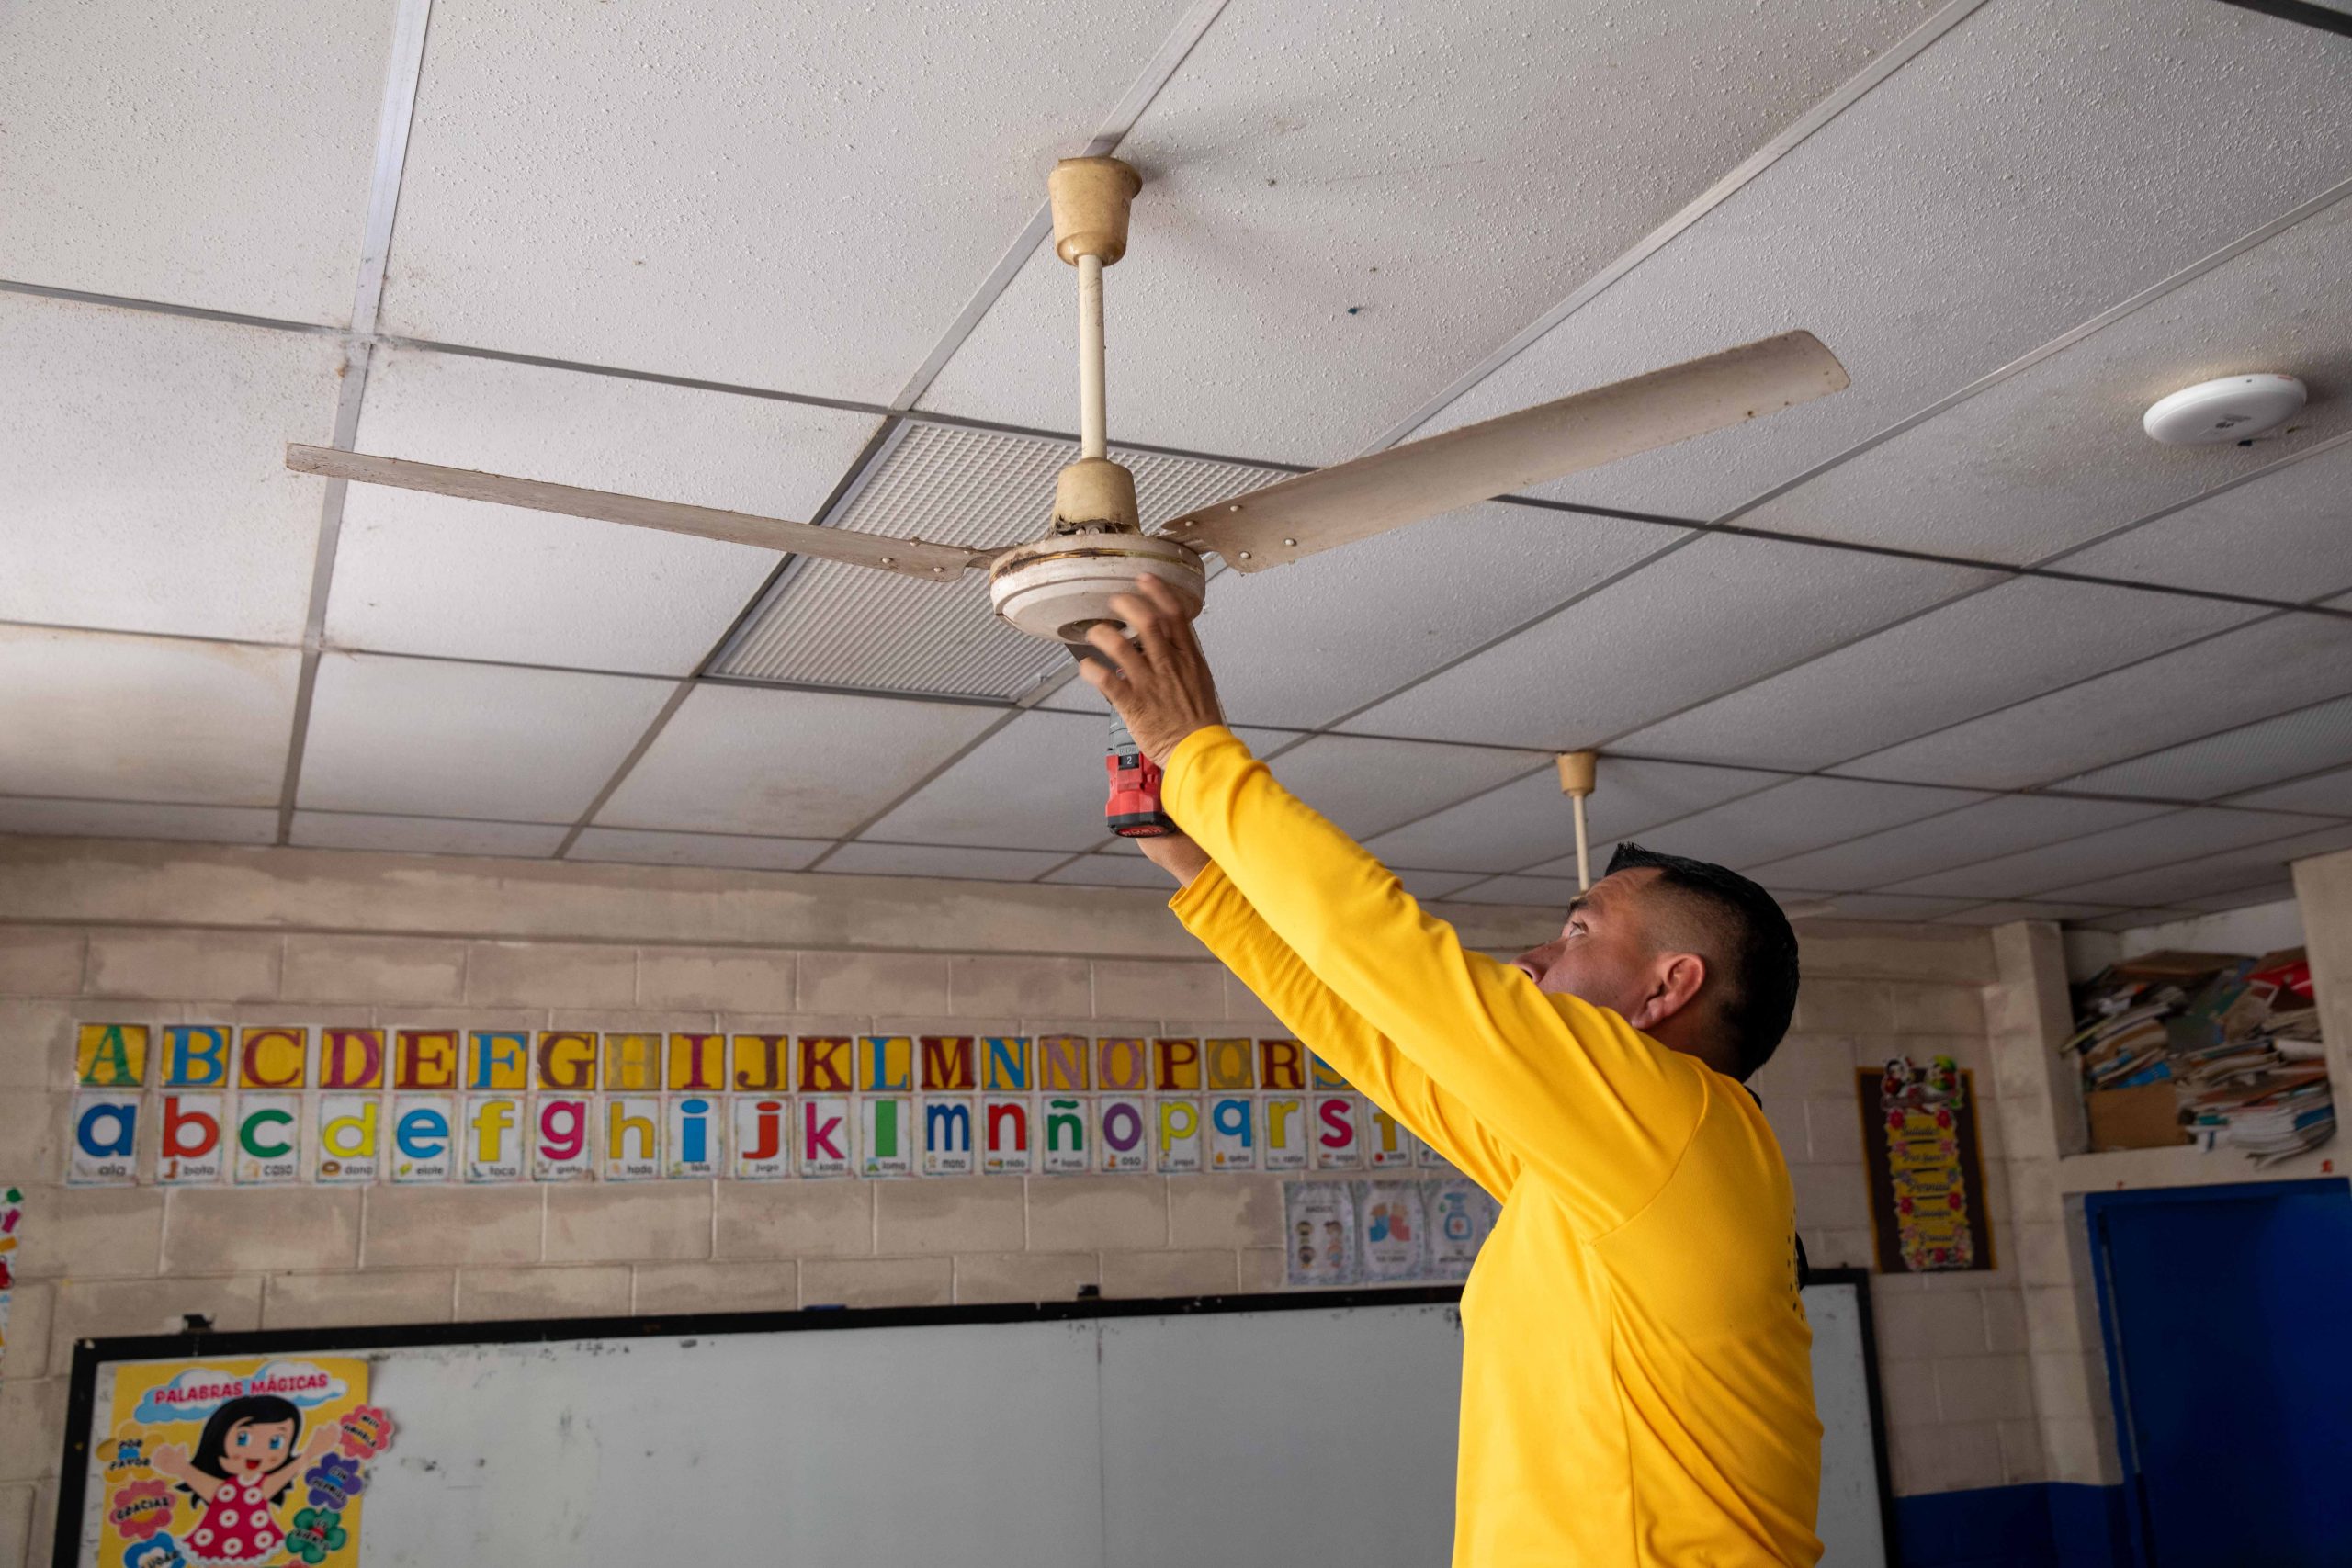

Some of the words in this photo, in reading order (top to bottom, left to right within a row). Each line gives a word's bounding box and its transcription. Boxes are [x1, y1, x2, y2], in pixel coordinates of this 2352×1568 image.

[1126, 755, 1133, 765] 2
[79, 1024, 137, 1086] A
[165, 1026, 223, 1086] B
[243, 1030, 301, 1087] C
[324, 1032, 379, 1088] D
[398, 1032, 454, 1088] E
[471, 1033, 525, 1088] F
[540, 1034, 596, 1088] G
[604, 1035, 660, 1089] H
[683, 1034, 712, 1089] I
[737, 1036, 784, 1089] J
[798, 1038, 851, 1090] K
[868, 1037, 907, 1089] L
[920, 1038, 975, 1088] M
[986, 1038, 1027, 1088] N
[1102, 1039, 1142, 1089] O
[1158, 1040, 1197, 1089] P
[1261, 1040, 1304, 1089] R
[78, 1103, 136, 1157] a
[162, 1097, 220, 1157] b
[241, 1110, 292, 1157] c
[322, 1102, 377, 1157] d
[397, 1110, 448, 1158] e
[472, 1101, 514, 1162] f
[540, 1101, 584, 1160] g
[609, 1102, 654, 1159] h
[681, 1100, 708, 1162] i
[742, 1101, 781, 1159] j
[806, 1102, 844, 1159] k
[876, 1100, 897, 1156] l
[927, 1104, 970, 1151] m
[988, 1104, 1026, 1151] n
[1047, 1100, 1082, 1150] ñ
[1103, 1104, 1141, 1151] o
[1160, 1101, 1197, 1152] p
[1214, 1100, 1251, 1147] q
[1269, 1101, 1299, 1148] r
[1320, 1100, 1353, 1148] s
[1121, 1156, 1140, 1166] oso
[98, 1164, 127, 1177] ala
[183, 1166, 215, 1176] bota
[263, 1164, 293, 1176] casa
[345, 1165, 373, 1176] dona
[416, 1166, 444, 1175] elote
[627, 1164, 653, 1174] hada
[153, 1382, 243, 1404] PALABRAS
[249, 1373, 327, 1394] MÁGICAS
[118, 1439, 142, 1450] POR
[108, 1458, 151, 1471] FAVOR
[116, 1496, 169, 1520] GRACIAS
